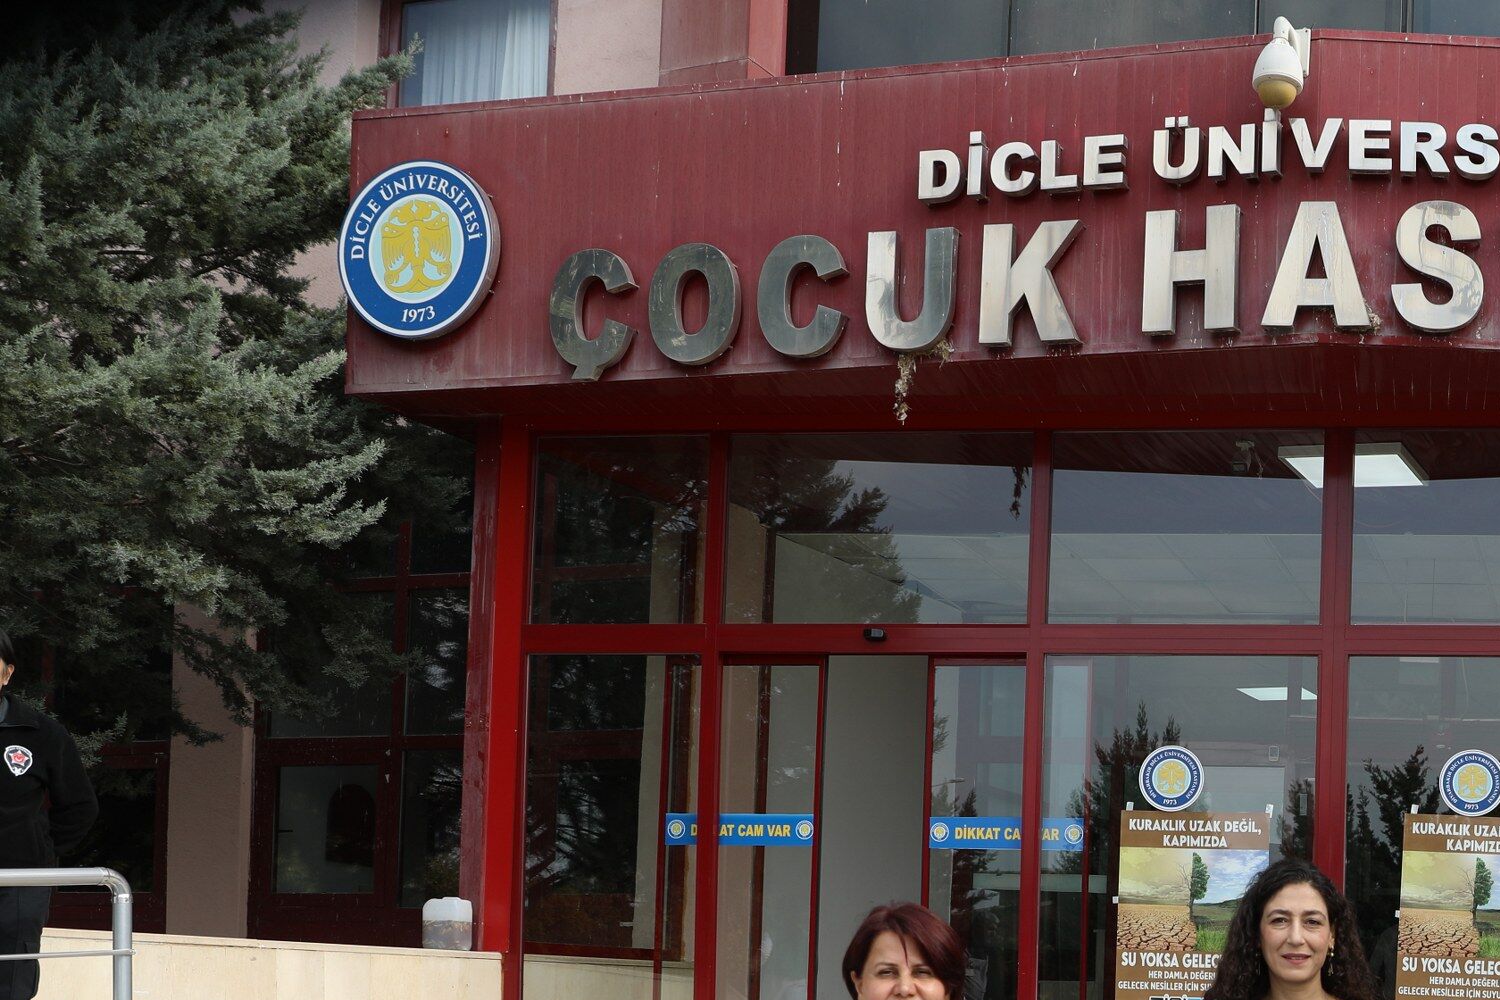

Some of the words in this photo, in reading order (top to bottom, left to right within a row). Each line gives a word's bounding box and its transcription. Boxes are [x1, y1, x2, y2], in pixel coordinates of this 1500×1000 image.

[918, 131, 1129, 207] DİCLE
[350, 199, 381, 260] DİCLE
[379, 172, 483, 242] ÜNİVERSİTESİ
[549, 219, 1084, 382] ÇOCUK
[401, 305, 436, 323] 1973
[1163, 798, 1177, 806] 1973
[690, 824, 735, 837] DAT
[738, 824, 764, 837] CAM
[767, 824, 791, 837] VAR
[954, 825, 1001, 840] DİKKAT
[1004, 827, 1022, 840] CA
[1041, 828, 1060, 841] AR
[1129, 818, 1187, 832] KURAKLIK
[1189, 820, 1221, 833] UZAK
[1224, 818, 1262, 836] DEĞİL,
[1412, 821, 1471, 836] KURAKLIK
[1163, 834, 1228, 848] KAPIMIZDA
[1121, 951, 1137, 967] SU
[1140, 952, 1180, 968] YOKSA
[1182, 953, 1222, 969] GELEC
[1402, 956, 1418, 972] SU
[1421, 957, 1461, 974] YOKSA
[1148, 971, 1163, 979] HER
[1164, 971, 1189, 980] DAMLA
[1429, 976, 1444, 985] HER
[1445, 977, 1471, 987] DAMLA
[1118, 981, 1149, 990] GELECEK
[1150, 980, 1183, 991] NESİLLER
[1184, 981, 1199, 993] İÇİN
[1398, 986, 1430, 996] GELECEK
[1431, 986, 1465, 998] NESİLLER
[1466, 988, 1481, 999] İÇİN
